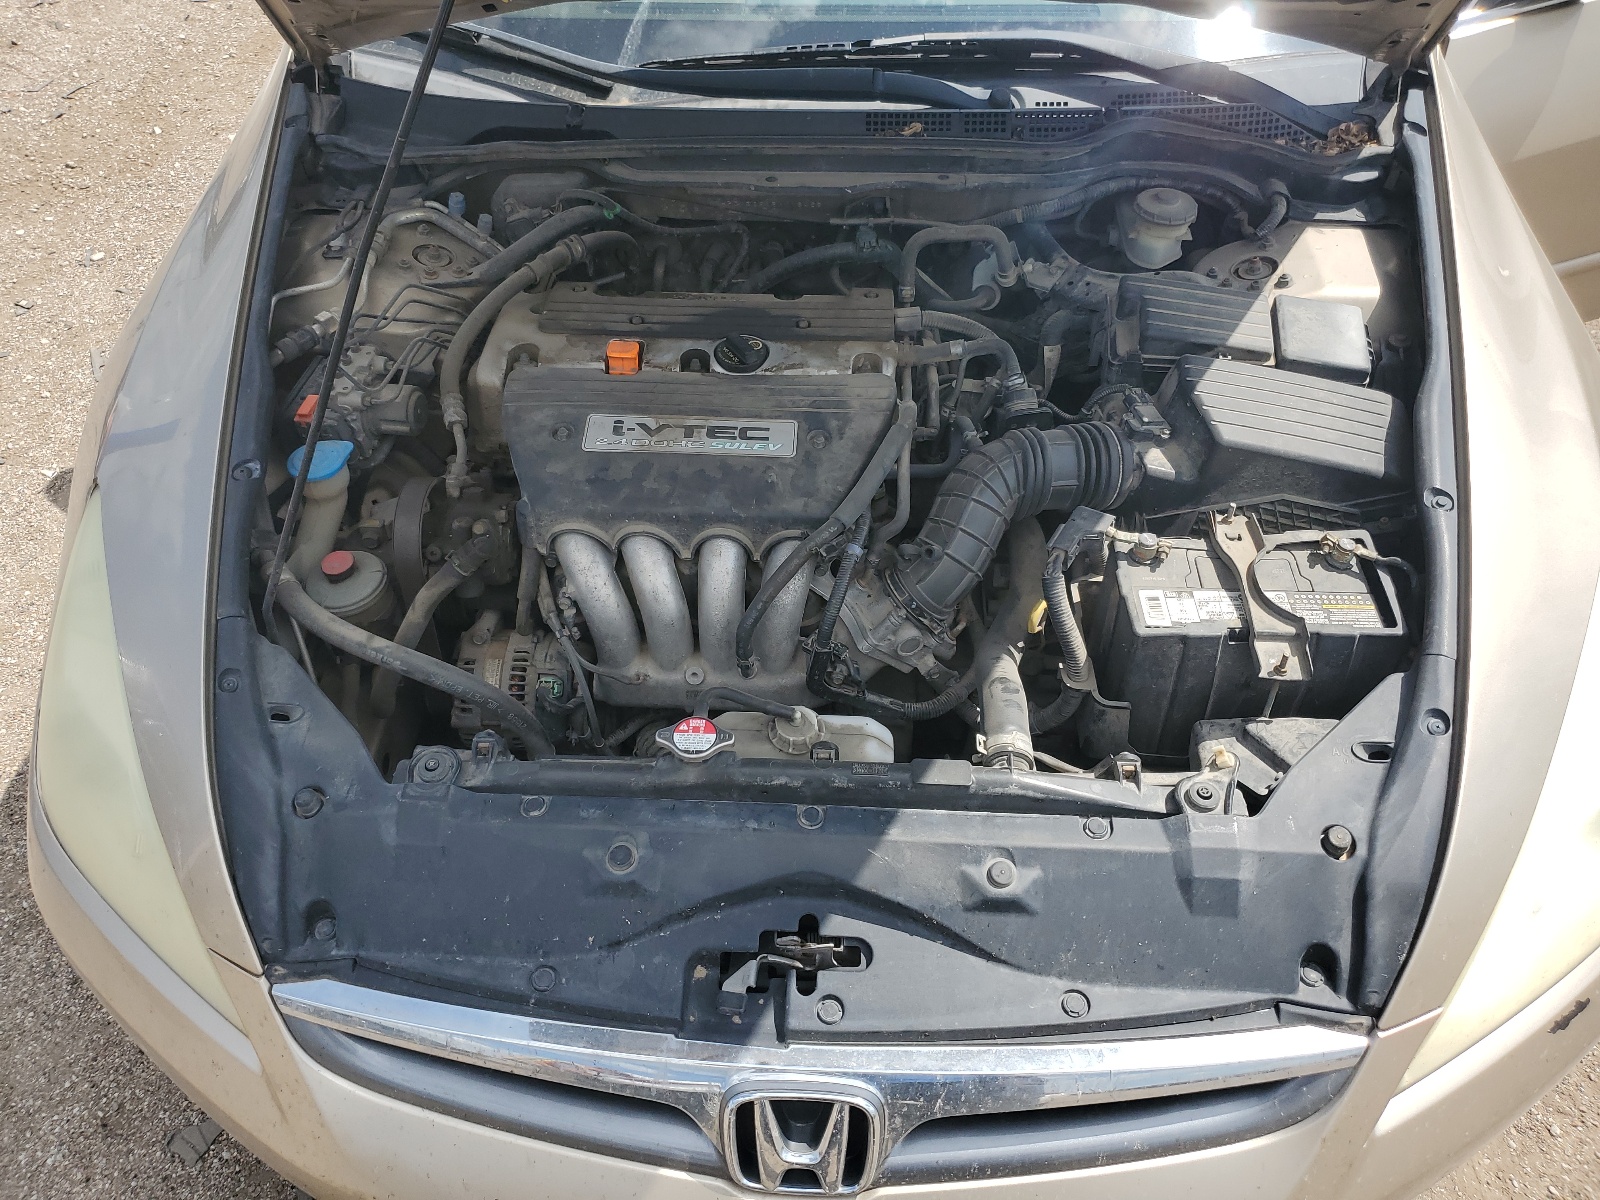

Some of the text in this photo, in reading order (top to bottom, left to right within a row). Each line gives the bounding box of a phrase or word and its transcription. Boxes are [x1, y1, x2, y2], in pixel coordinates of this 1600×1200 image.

[612, 420, 770, 441] i-VTEC
[631, 439, 706, 448] DOHC
[709, 441, 784, 451] SULEV
